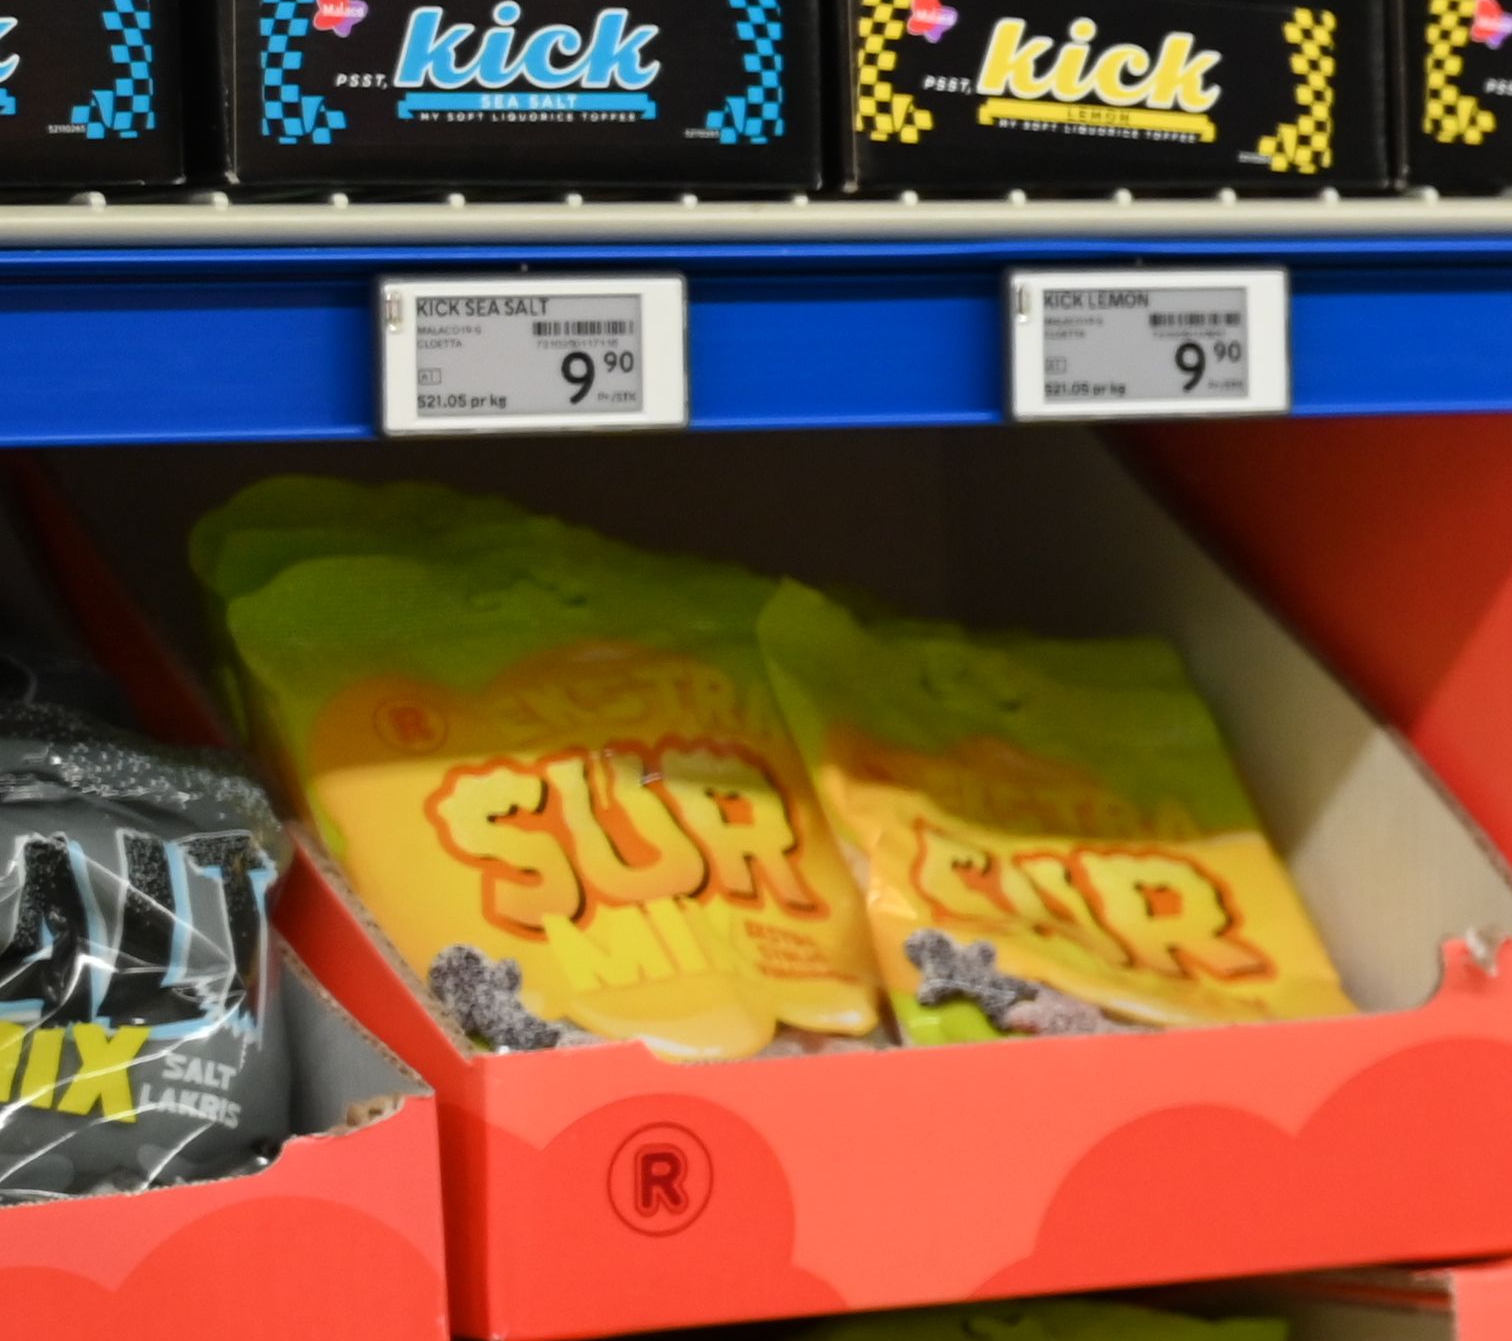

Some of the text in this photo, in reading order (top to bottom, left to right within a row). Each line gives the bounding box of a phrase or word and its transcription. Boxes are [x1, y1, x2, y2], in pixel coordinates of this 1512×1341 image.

[394, 0, 660, 89] kick
[976, 17, 1222, 113] kick
[336, 74, 388, 89] PSST,
[923, 75, 973, 95] PSST,
[481, 94, 578, 109] SEA SALT
[1066, 106, 1131, 127] LEMON
[420, 112, 637, 122] MY SOFT LIQUORICE TOFFEE
[417, 297, 549, 316] KICK SEA SALT
[1044, 290, 1149, 309] KICK LEMON
[561, 351, 635, 405] 9 90
[1175, 341, 1242, 393] 9 90
[417, 394, 507, 412] 521.05 pr kg
[424, 735, 829, 943] SUR
[0, 831, 277, 1044] ALT
[160, 1051, 239, 1091] SALT
[139, 1083, 243, 1130] LAKRIS
